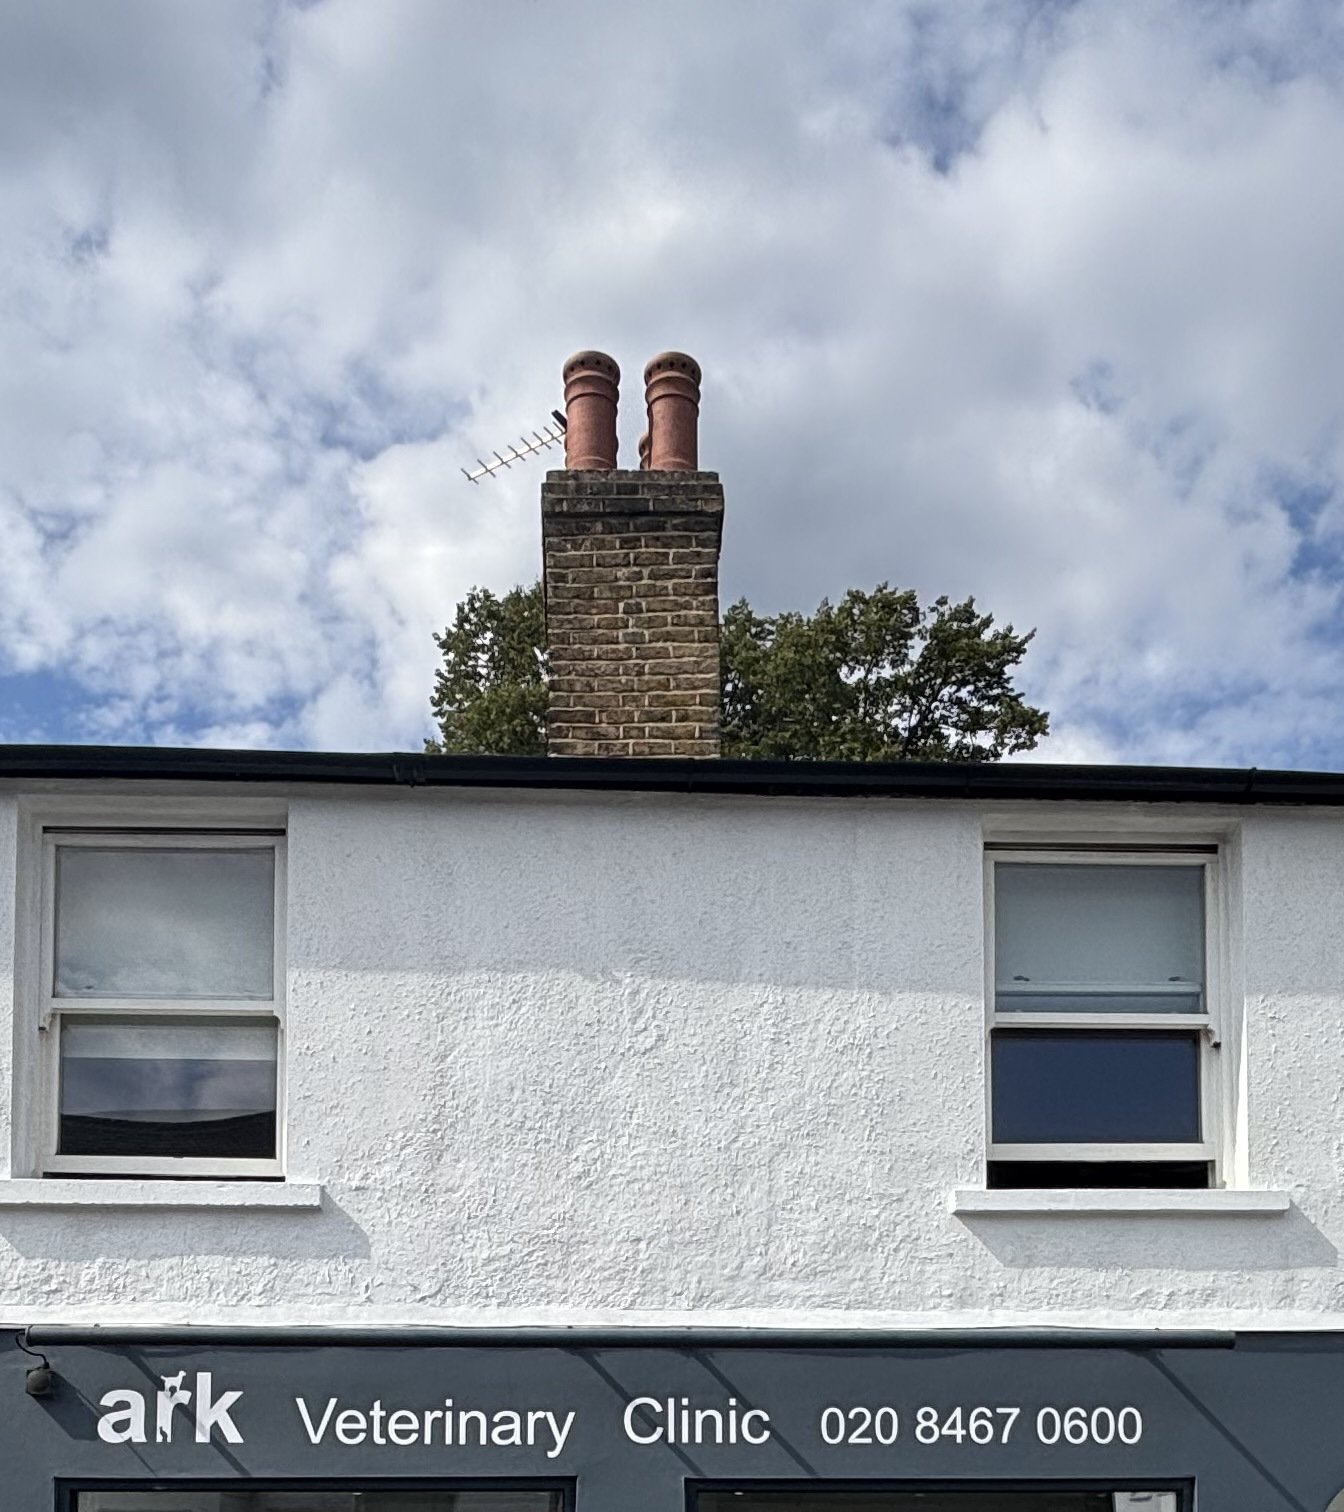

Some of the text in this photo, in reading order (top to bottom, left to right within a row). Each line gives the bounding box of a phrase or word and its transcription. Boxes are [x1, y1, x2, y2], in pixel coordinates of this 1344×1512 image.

[96, 1370, 1143, 1459] ark Veterinary Clinic 020 8467 0600
